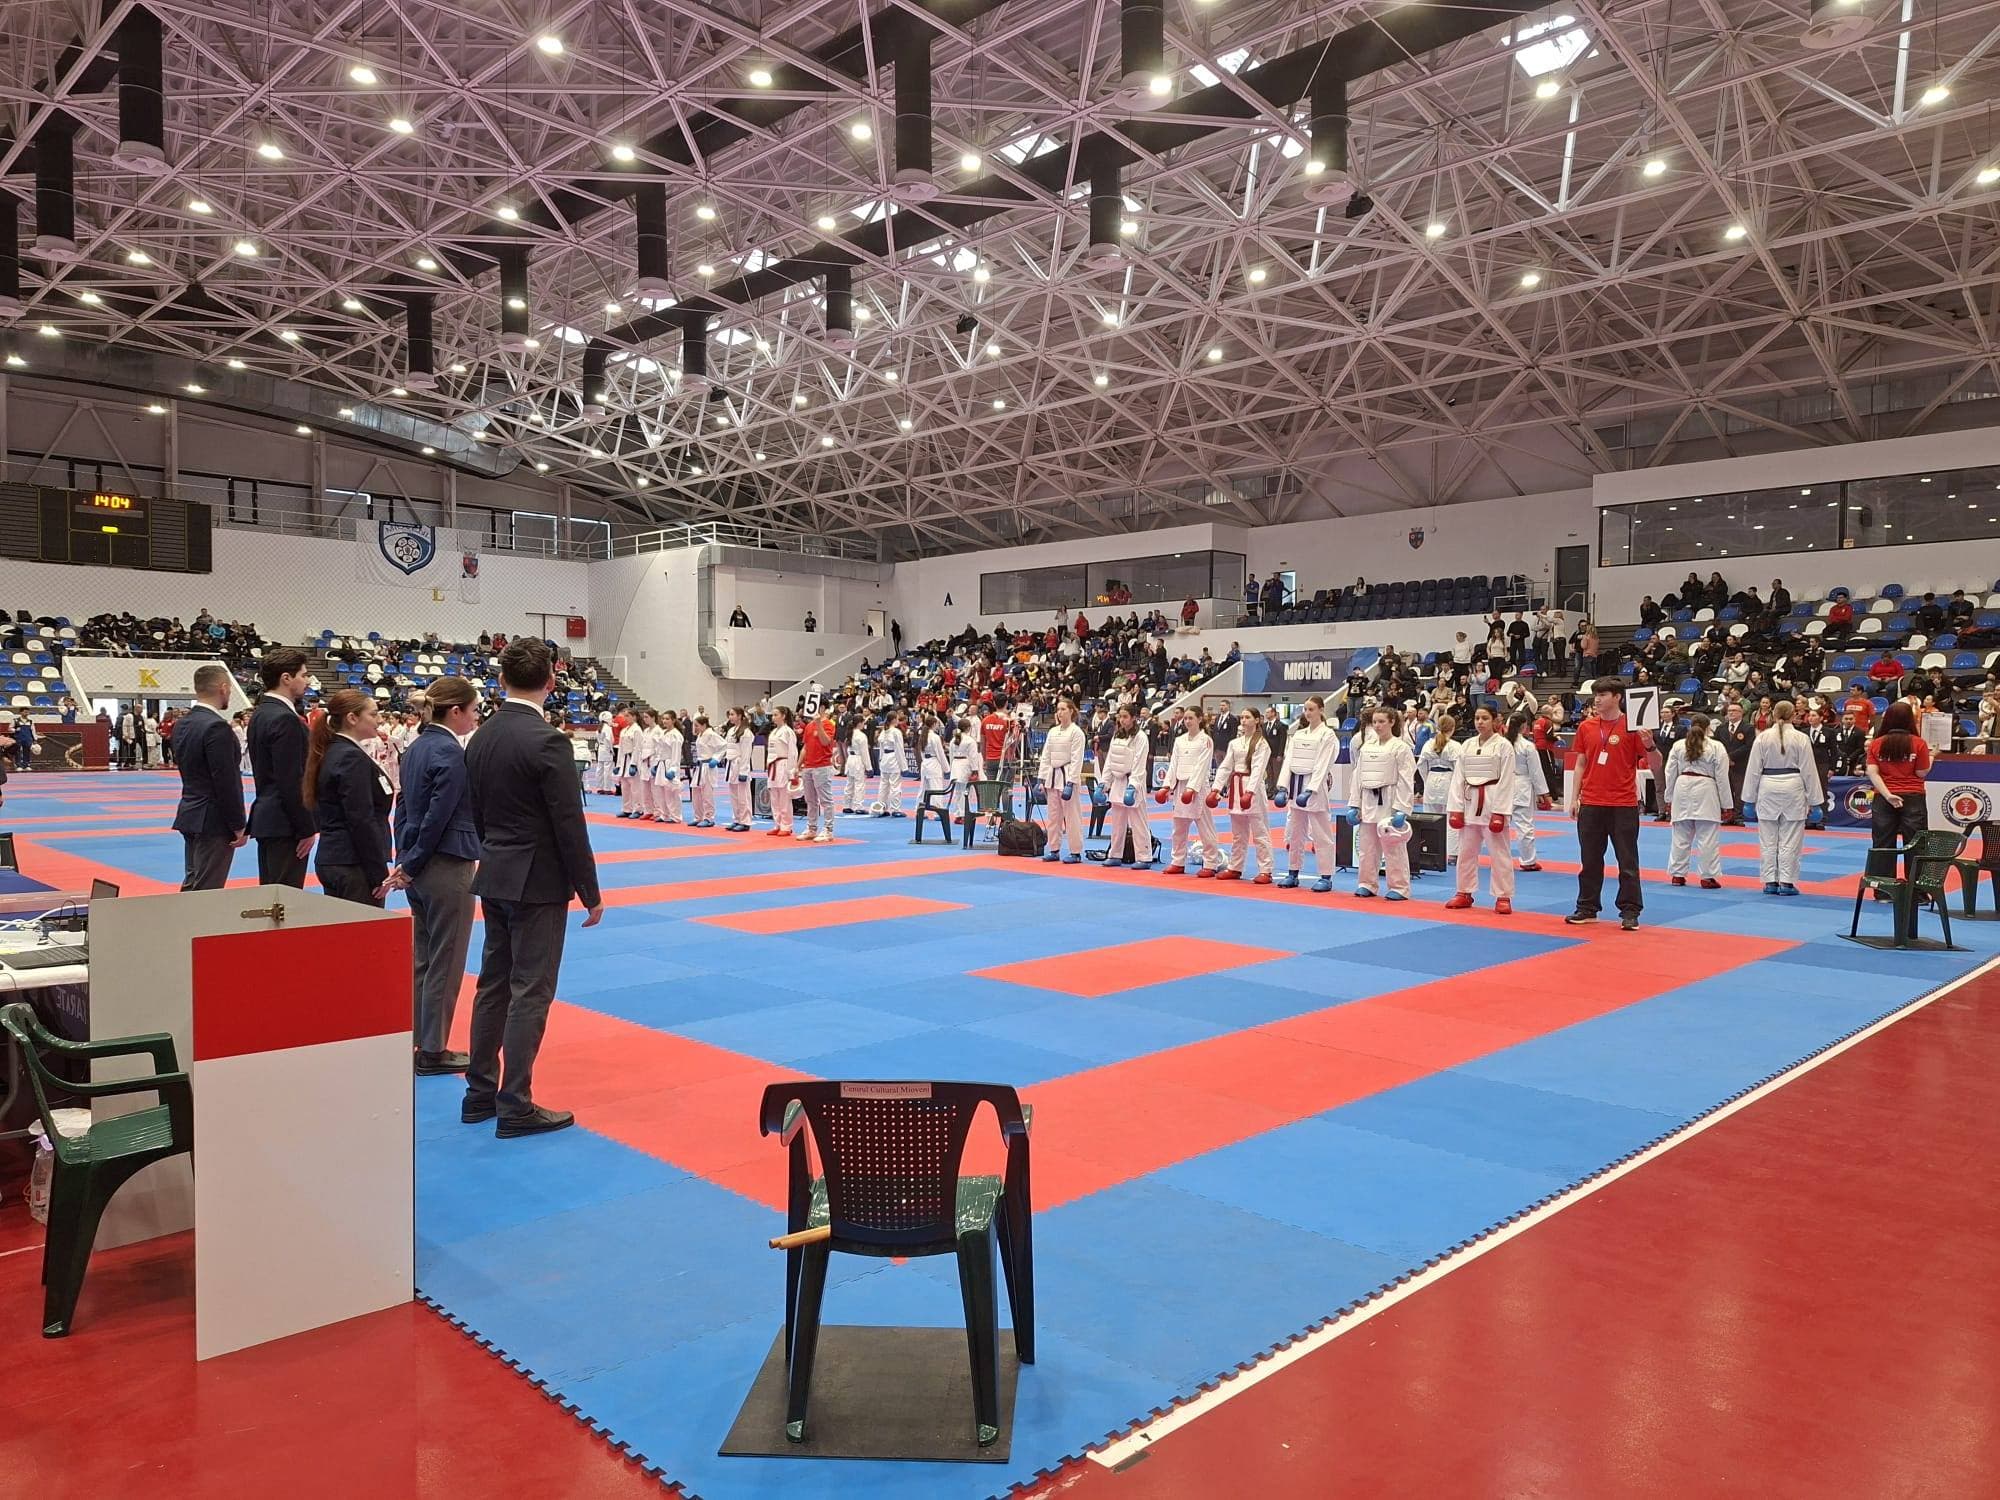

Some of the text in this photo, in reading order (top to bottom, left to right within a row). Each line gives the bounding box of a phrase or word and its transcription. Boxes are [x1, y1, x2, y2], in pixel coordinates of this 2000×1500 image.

[432, 588, 445, 601] L
[944, 592, 953, 606] A
[138, 667, 160, 688] K
[1284, 661, 1332, 680] MIOVENI
[806, 694, 818, 714] 5
[1630, 691, 1654, 726] 7
[985, 723, 1004, 731] STAFF
[901, 1085, 930, 1093] Mioveni
